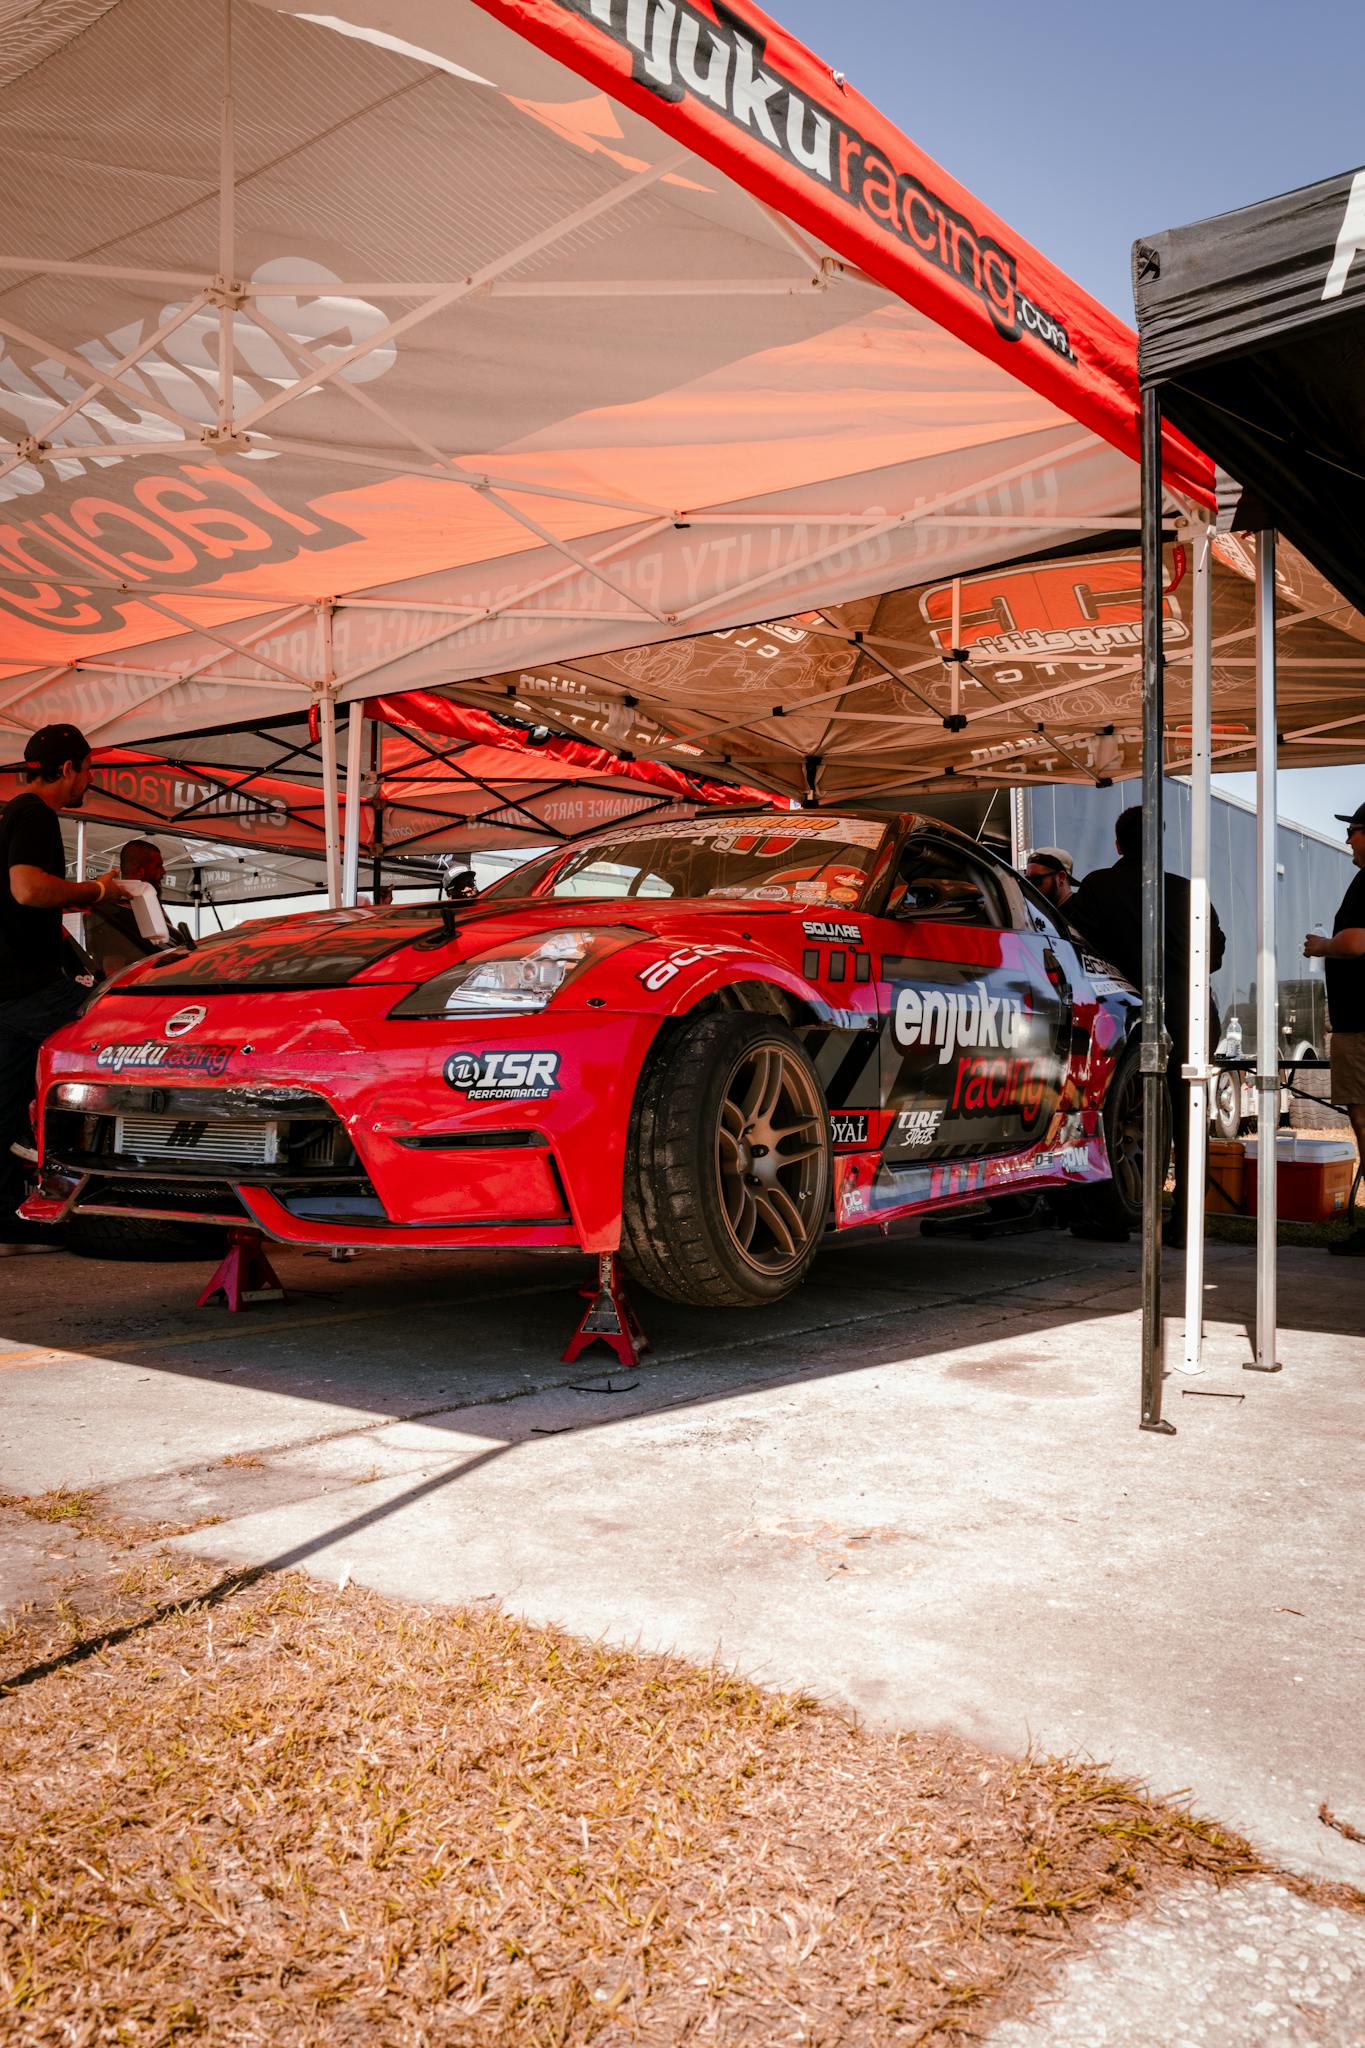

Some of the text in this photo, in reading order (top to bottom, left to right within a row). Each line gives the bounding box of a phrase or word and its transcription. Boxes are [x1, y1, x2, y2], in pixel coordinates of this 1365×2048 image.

[802, 921, 861, 938] SQUARE
[895, 981, 1022, 1065] enjuku
[476, 1053, 558, 1088] ISR
[467, 1088, 550, 1100] PERFORMANCE
[952, 1055, 1048, 1122] racing
[898, 1110, 943, 1129] TIRE
[900, 1127, 936, 1149] STREETS
